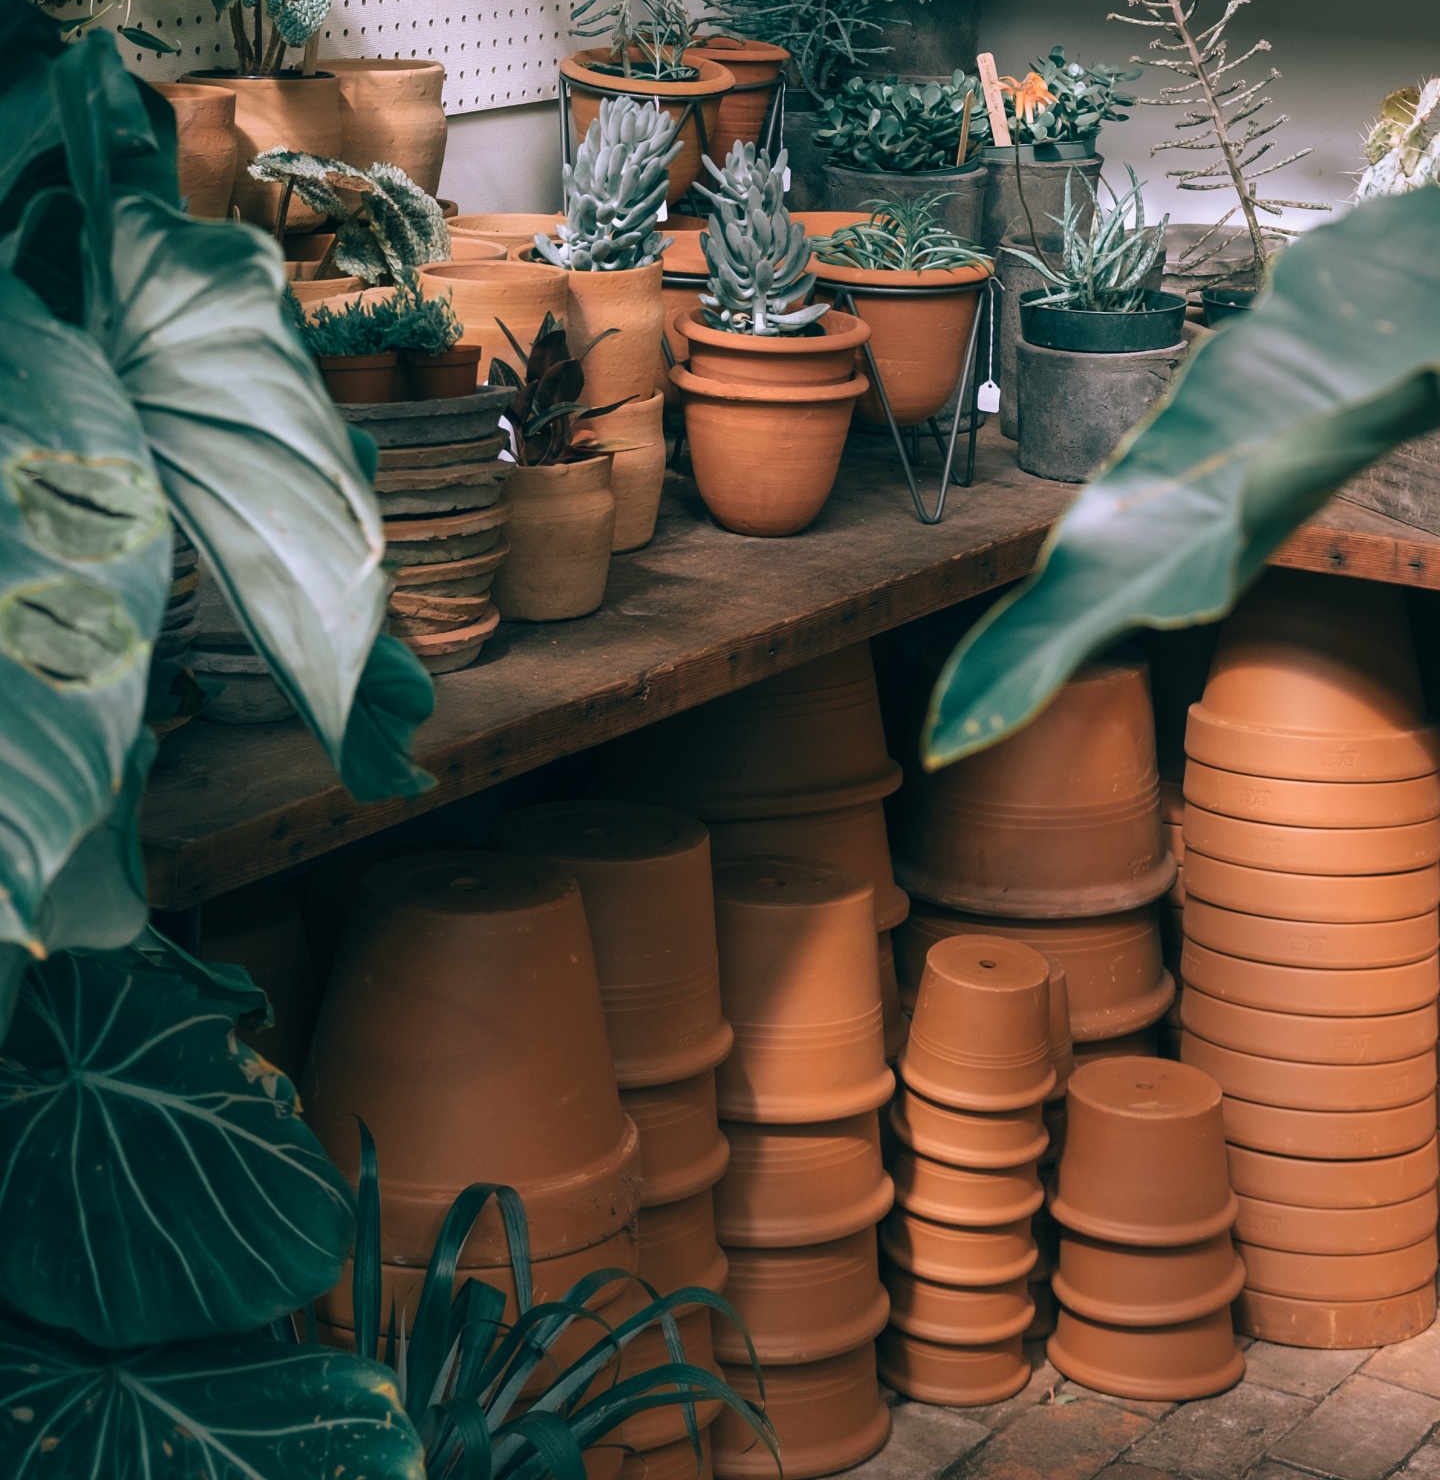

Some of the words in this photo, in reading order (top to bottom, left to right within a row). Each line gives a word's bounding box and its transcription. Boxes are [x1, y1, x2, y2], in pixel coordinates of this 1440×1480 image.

[1321, 756, 1336, 767] 23
[1339, 756, 1354, 767] EV
[1308, 942, 1323, 952] EV
